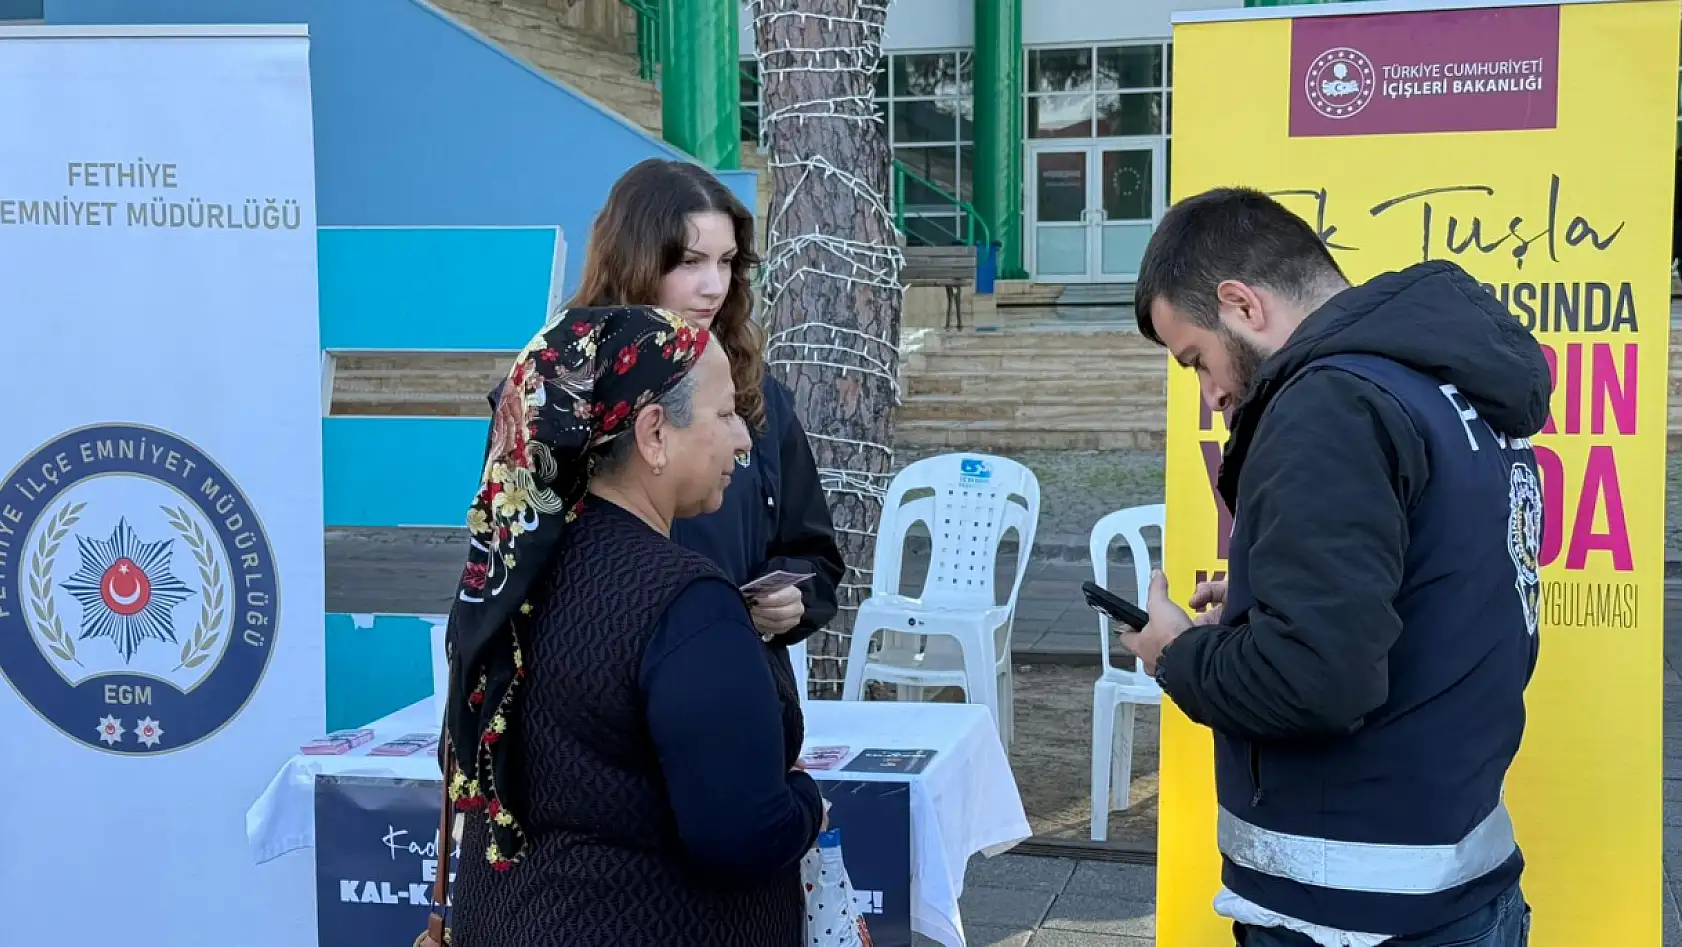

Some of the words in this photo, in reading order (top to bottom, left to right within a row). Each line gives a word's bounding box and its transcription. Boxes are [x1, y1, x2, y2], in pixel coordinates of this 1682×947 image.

[1382, 62, 1440, 79] TÜRKİYE
[1444, 57, 1543, 77] CUMHURİYETİ
[1383, 78, 1447, 98] İÇİŞLERİ
[1452, 75, 1542, 93] BAKANLIĞI
[67, 157, 178, 188] FETHİYE
[0, 195, 117, 226] EMNİYET
[127, 197, 301, 230] MÜDÜRLÜĞÜ
[1369, 173, 1625, 271] Tuşla
[1482, 281, 1639, 333] ISINDA
[14, 452, 73, 501] İLÇE
[79, 436, 197, 479] EMNİYET
[200, 476, 269, 648] MÜDÜRLÜĞÜ
[1541, 580, 1639, 629] YGULAMASI
[104, 684, 153, 706] EGM
[382, 824, 461, 861] Kad
[339, 879, 453, 907] KAL-K
